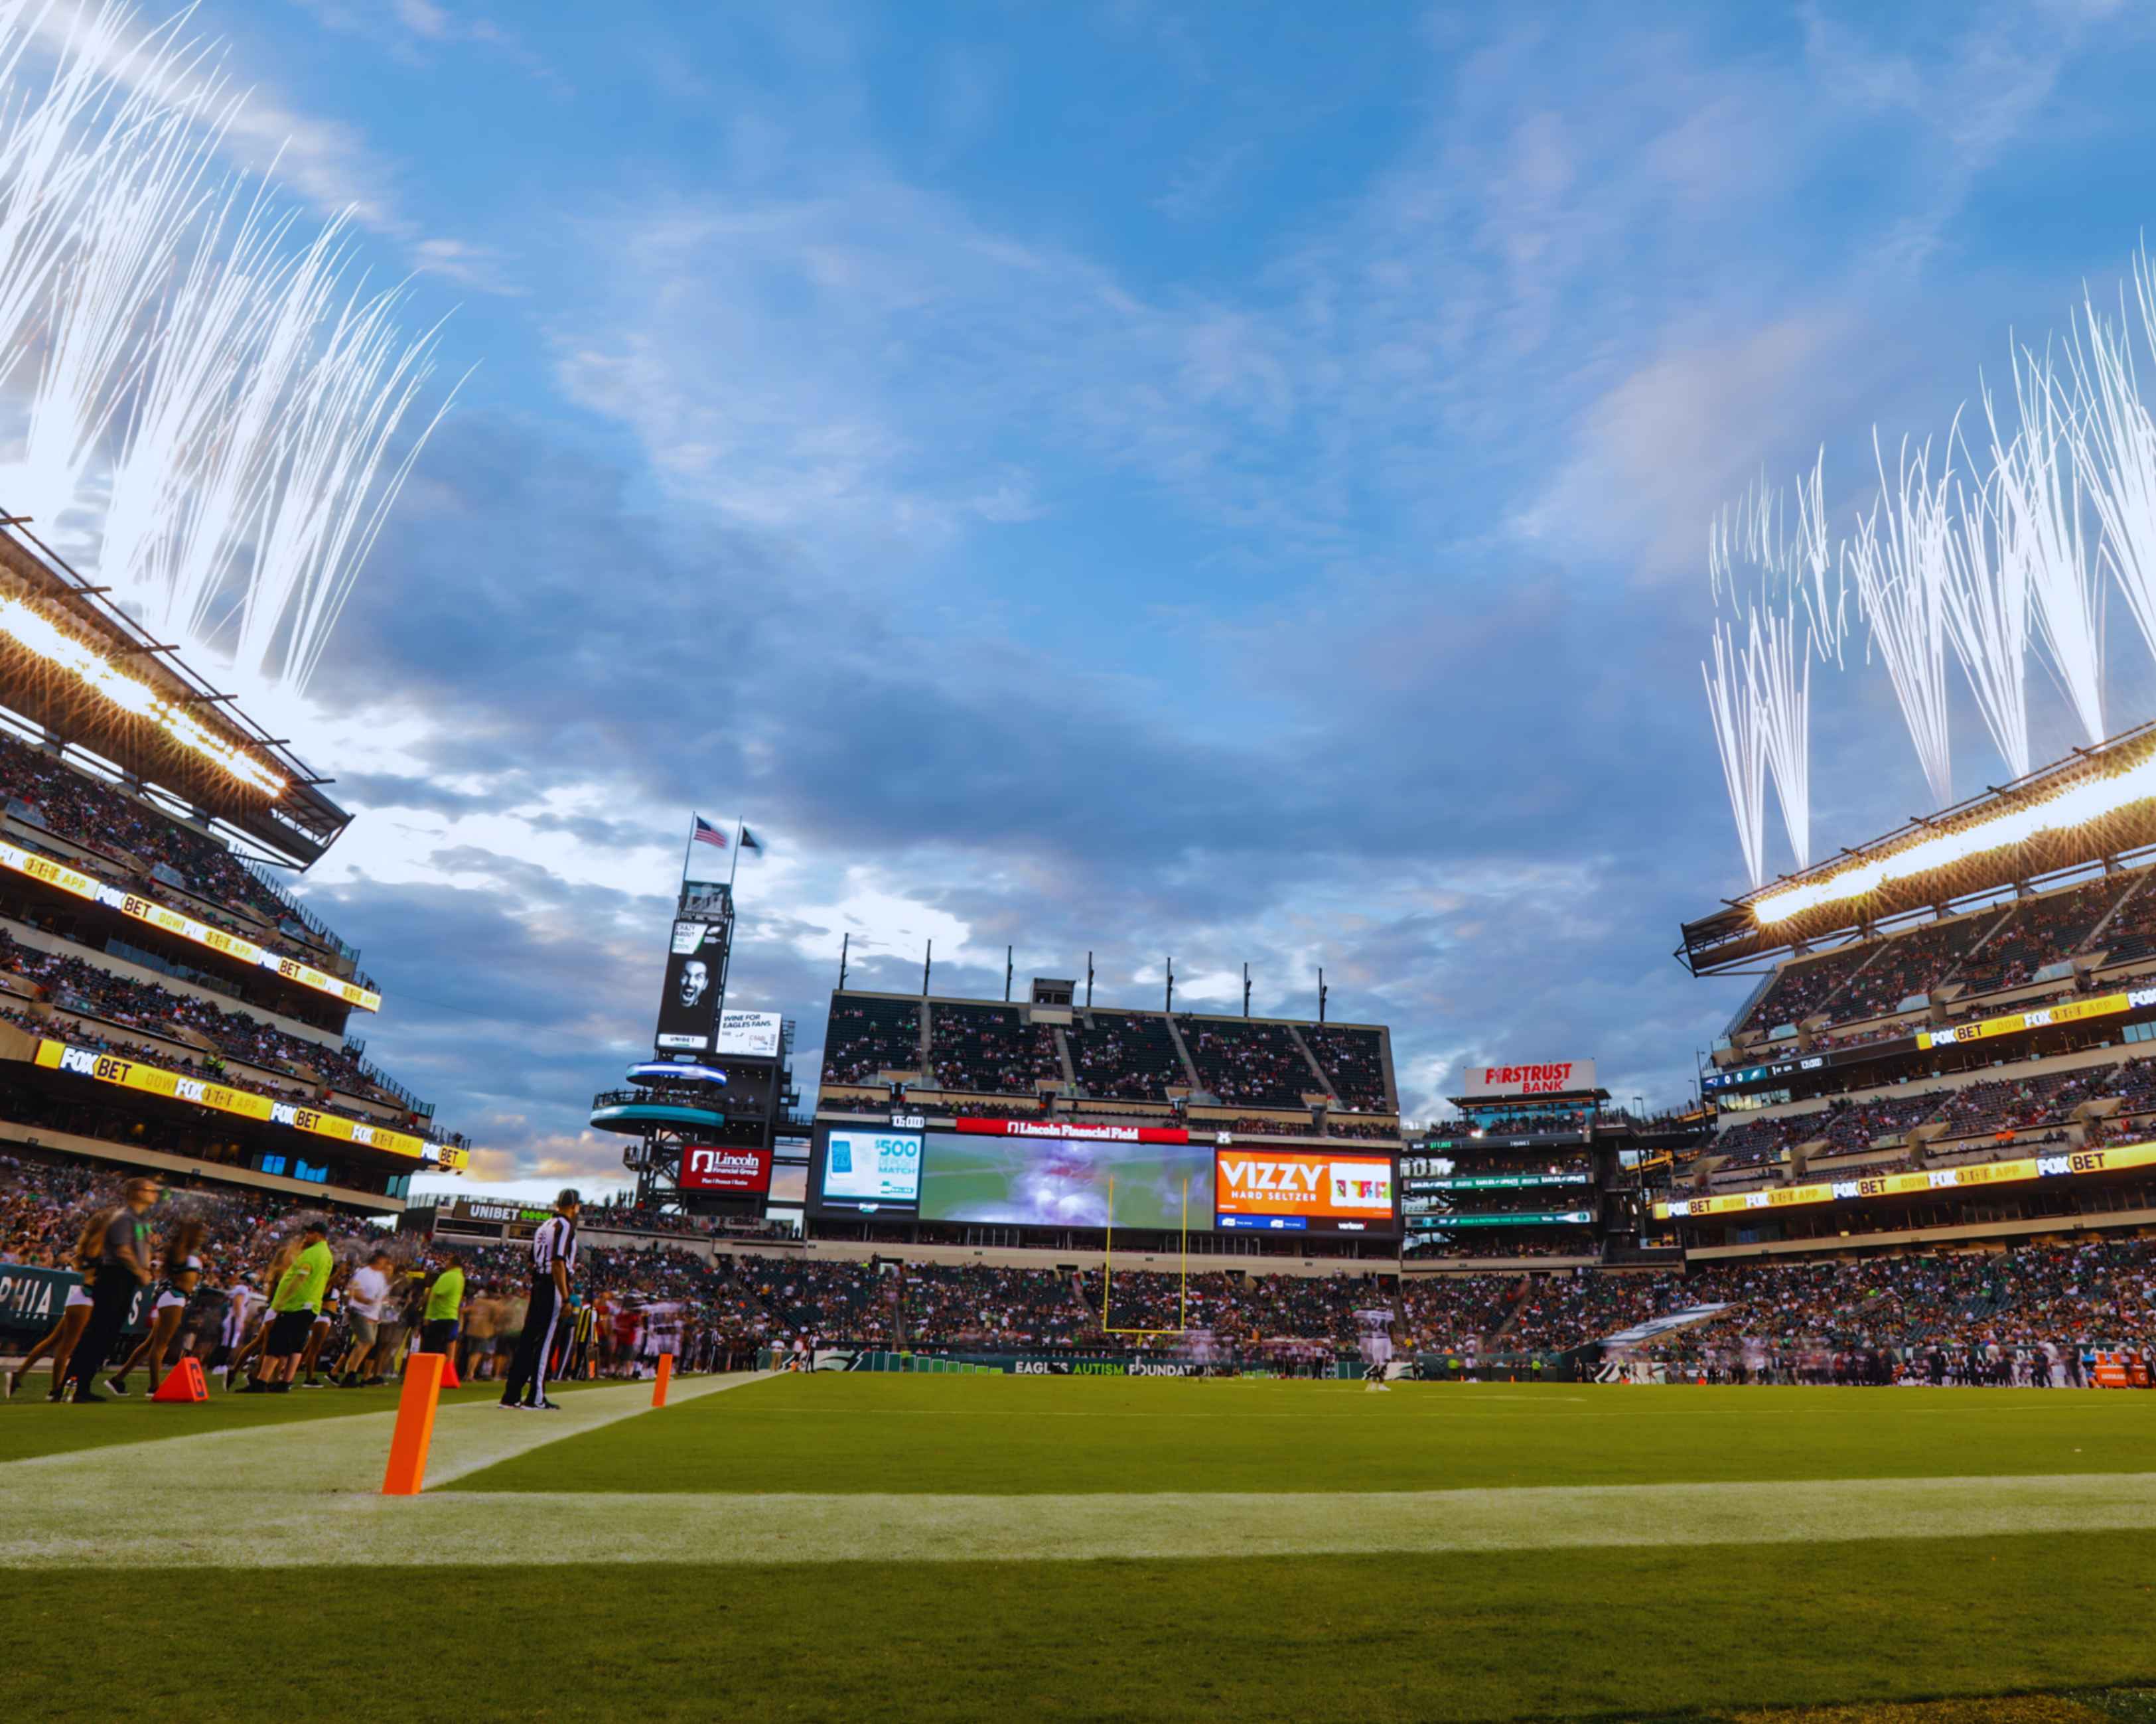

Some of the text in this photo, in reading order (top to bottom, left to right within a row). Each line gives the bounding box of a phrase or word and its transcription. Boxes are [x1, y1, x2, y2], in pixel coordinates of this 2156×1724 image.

[124, 896, 152, 918] BET
[279, 960, 301, 979] BET
[1930, 1029, 1958, 1046] FOX
[1958, 1024, 1983, 1041] BET
[60, 1047, 100, 1075] FOX
[96, 1058, 132, 1083] BET
[1485, 1063, 1572, 1084] FIRSTRUST
[1522, 1080, 1564, 1094] BANK
[1725, 1075, 1731, 1084] 0
[1737, 1072, 1743, 1082] 0
[270, 1102, 298, 1125] FOX
[297, 1110, 322, 1129] BET
[1019, 1121, 1139, 1140] Lincoln Financial Field
[440, 1147, 459, 1163] BET
[875, 1139, 918, 1157] $500
[715, 1151, 759, 1166] Lincoln
[2037, 1153, 2106, 1176] FOX BET
[739, 1168, 758, 1177] Group
[1219, 1160, 1325, 1191] VIZZY
[1231, 1191, 1317, 1202] HARD SELTZER
[1832, 1183, 1859, 1198] FOX
[1859, 1179, 1887, 1194] BET
[470, 1204, 520, 1221] UNIBET
[1690, 1199, 1711, 1214] BET
[1338, 1222, 1365, 1231] verizon
[1015, 1361, 1069, 1374] EAGLS
[1073, 1363, 1125, 1375] AUTISM
